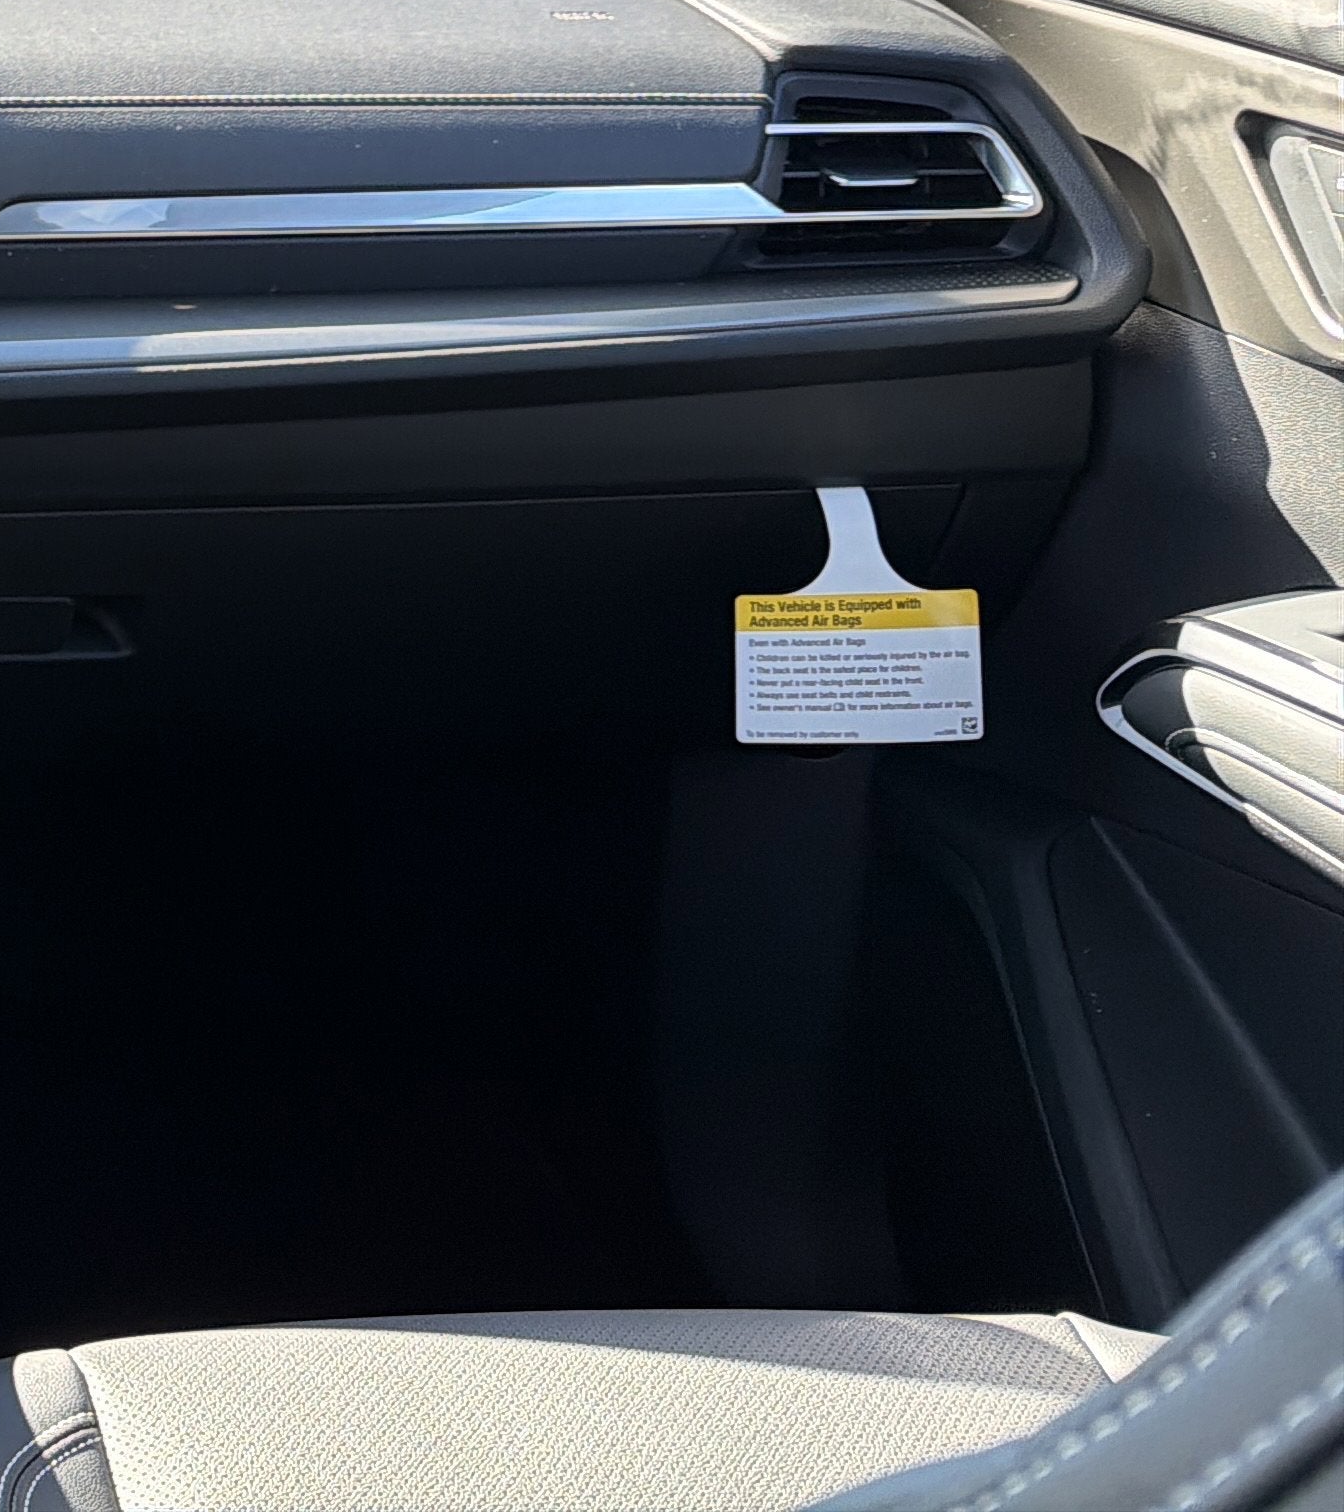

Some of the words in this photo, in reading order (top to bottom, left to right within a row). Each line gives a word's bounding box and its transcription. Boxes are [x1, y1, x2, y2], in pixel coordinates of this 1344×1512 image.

[749, 600, 775, 613] This
[777, 599, 822, 612] Vehicle
[824, 599, 835, 612] is
[838, 598, 893, 613] Equipped
[895, 598, 921, 609] with
[749, 615, 809, 627] Advanced
[812, 614, 829, 626] Air
[832, 614, 863, 628] Bags
